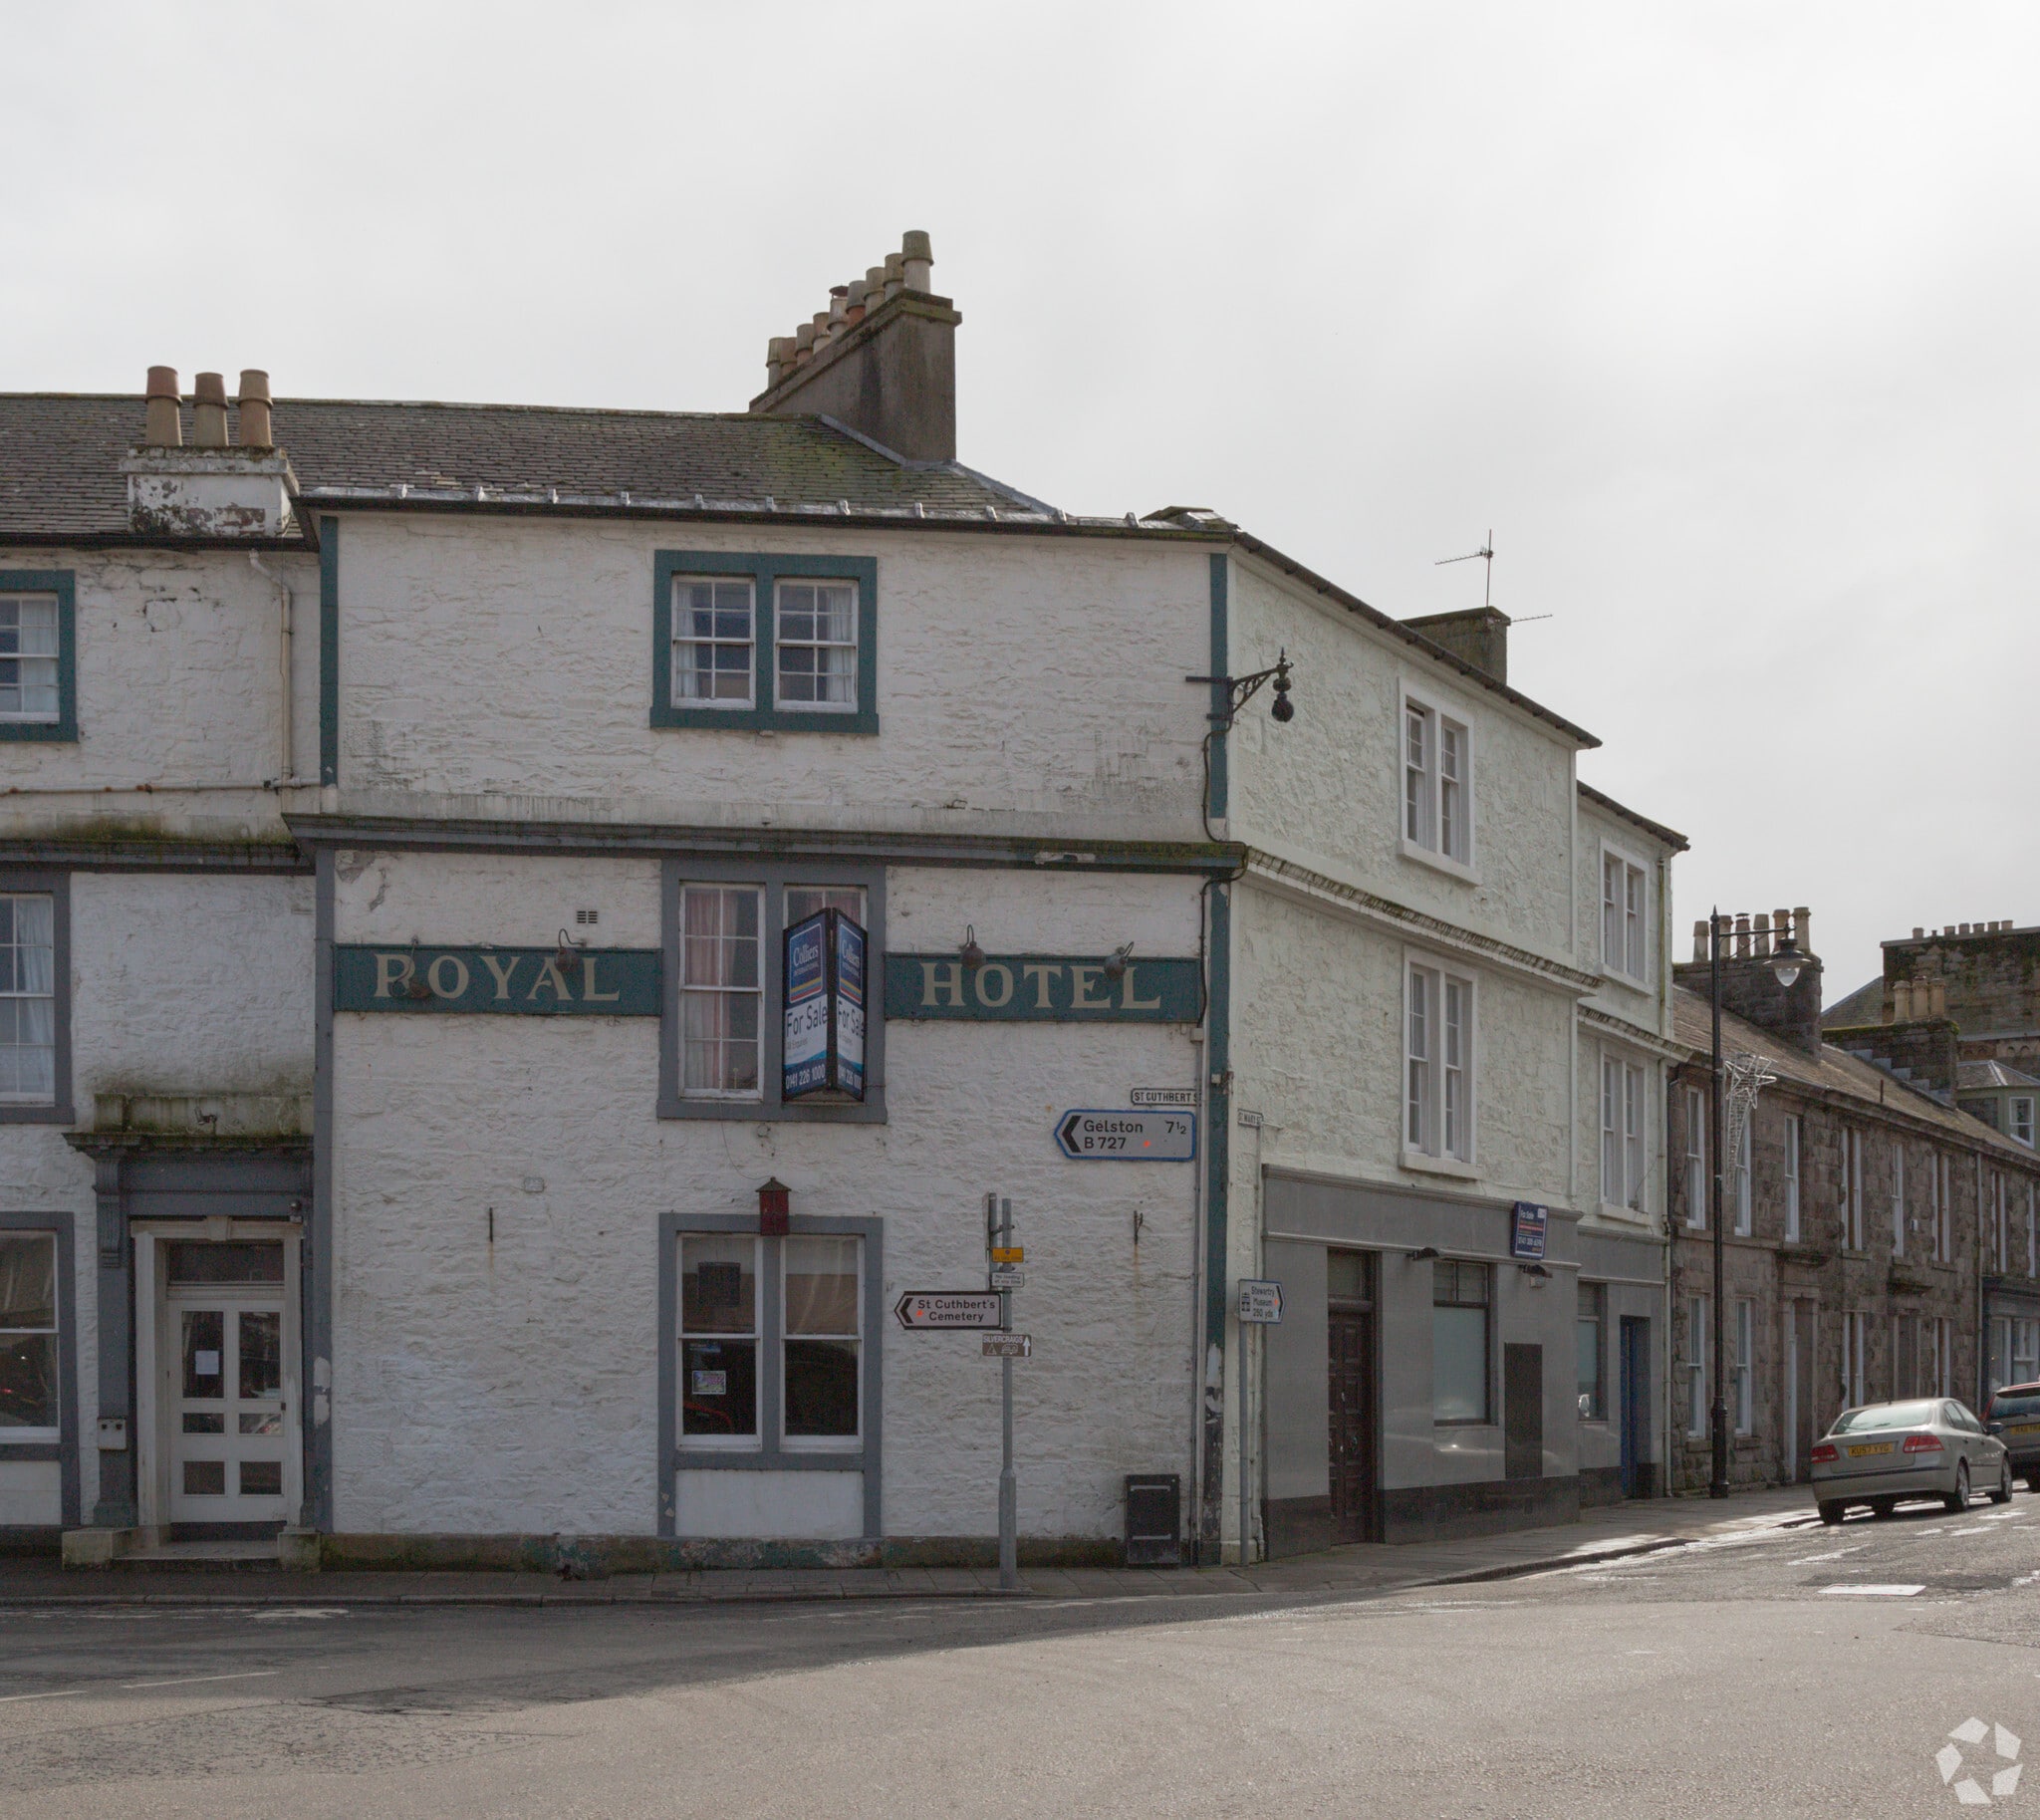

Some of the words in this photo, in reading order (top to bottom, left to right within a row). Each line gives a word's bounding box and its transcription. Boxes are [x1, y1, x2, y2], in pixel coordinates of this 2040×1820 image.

[793, 943, 819, 966] Colliers
[374, 952, 621, 1001] ROYAL
[920, 962, 1161, 1009] HOTEL
[787, 1012, 804, 1037] For
[806, 999, 828, 1031] Sale
[1146, 1092, 1191, 1103] CUTHBERT
[1084, 1120, 1144, 1134] Gelston
[917, 1299, 931, 1309] St
[935, 1299, 995, 1309] Cuthbert's
[1253, 1297, 1272, 1307] Museum
[928, 1311, 984, 1323] Cemetery
